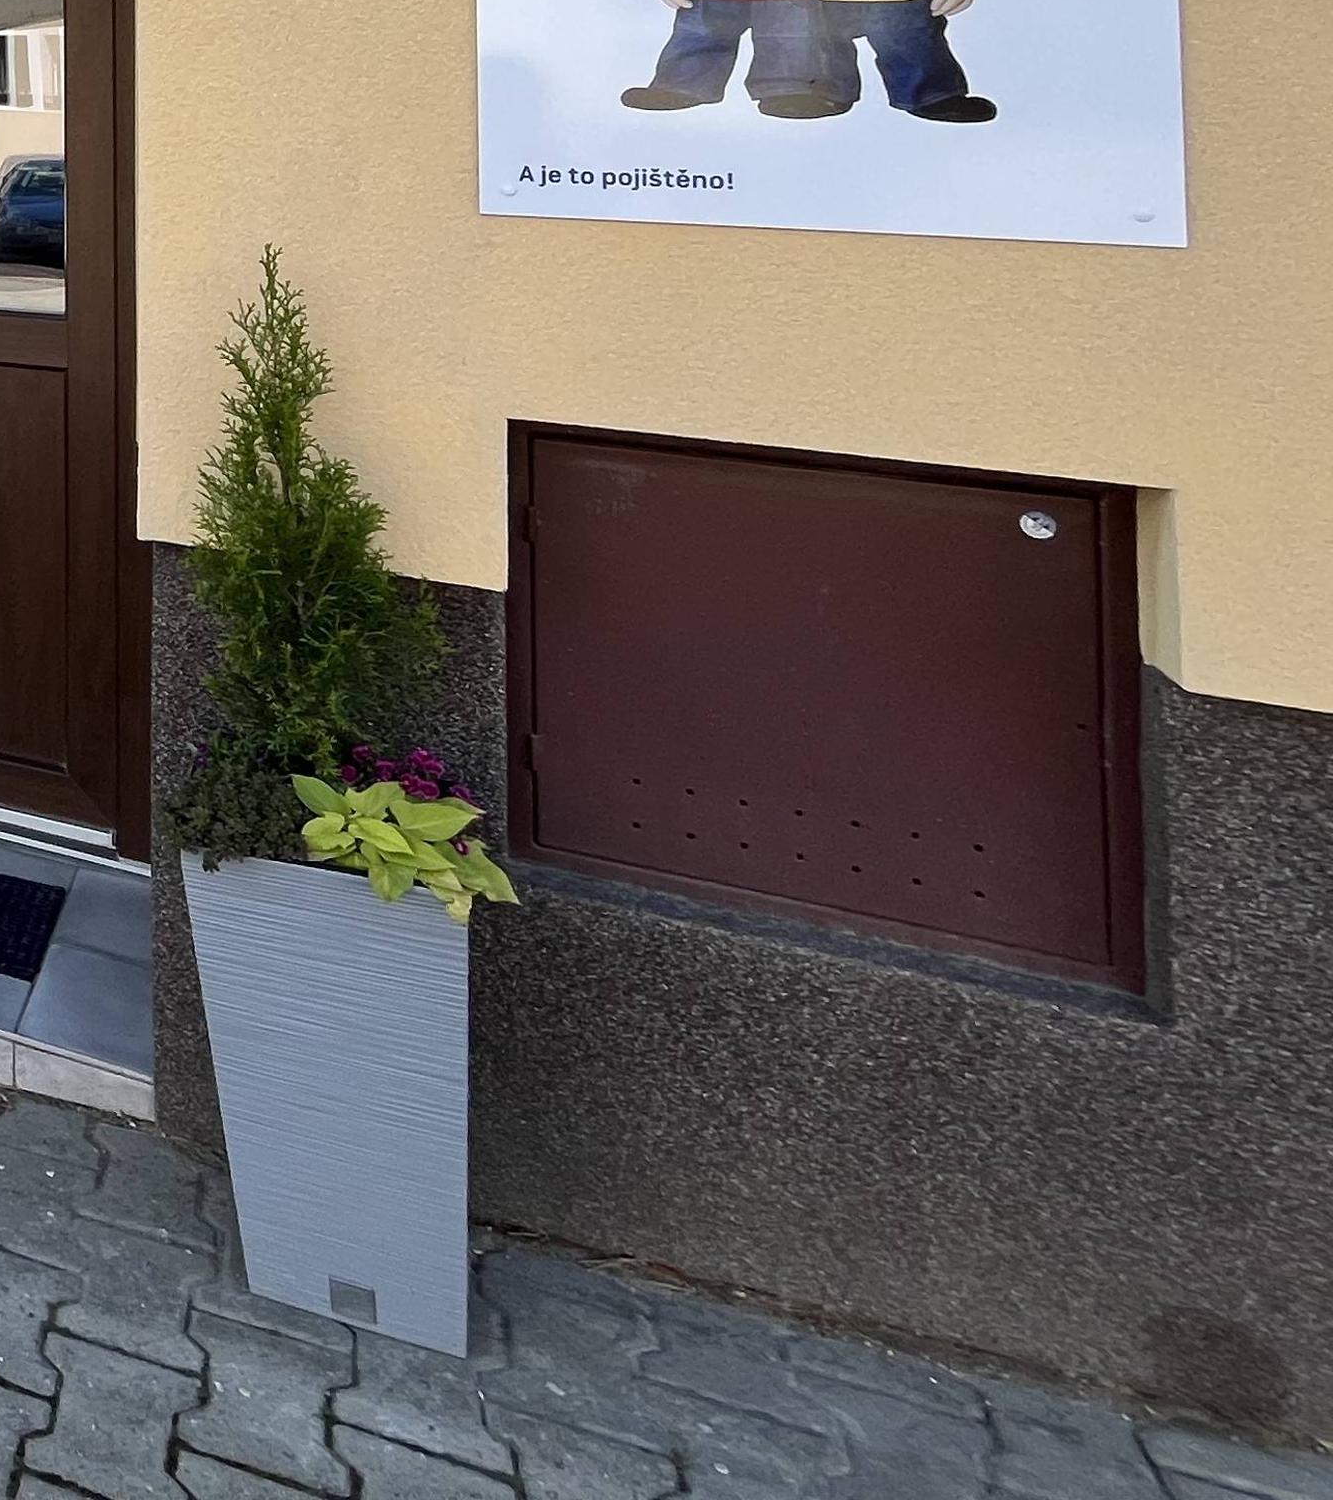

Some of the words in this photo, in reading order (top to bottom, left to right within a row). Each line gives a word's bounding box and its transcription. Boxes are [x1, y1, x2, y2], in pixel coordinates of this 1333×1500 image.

[519, 165, 534, 182] A
[538, 165, 561, 187] je
[568, 168, 594, 185] to
[602, 168, 734, 191] pojištěno!
